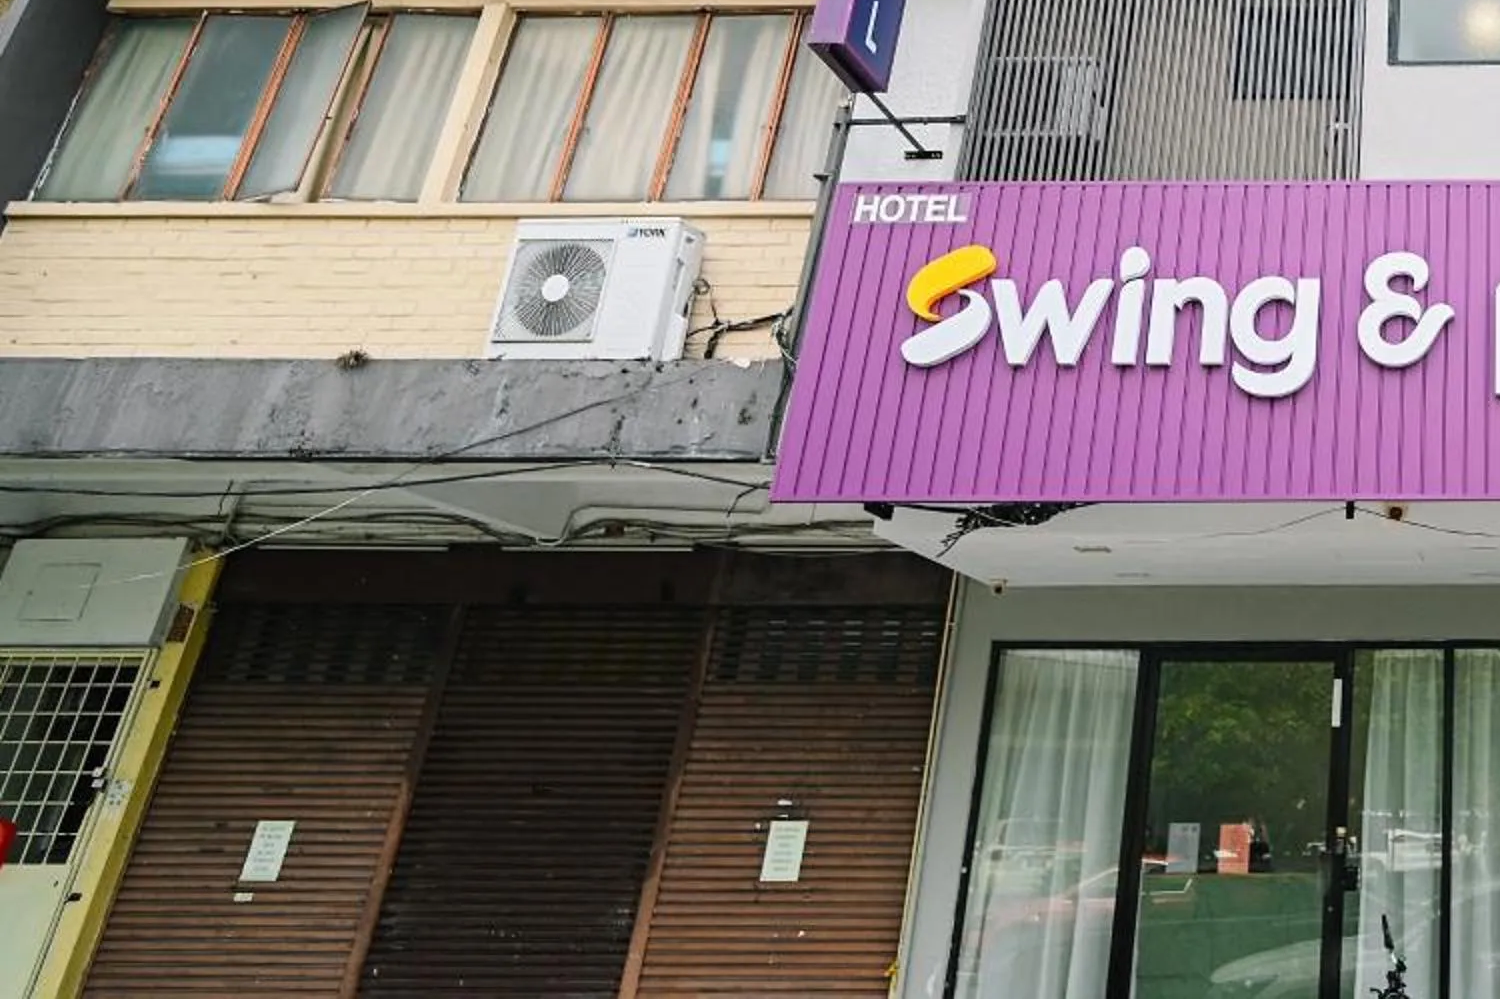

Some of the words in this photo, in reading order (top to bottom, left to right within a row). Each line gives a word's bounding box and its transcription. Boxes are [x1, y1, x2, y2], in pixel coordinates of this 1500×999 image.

[853, 194, 968, 222] HOTEL
[900, 243, 1321, 399] Swing
[1357, 250, 1455, 369] &
